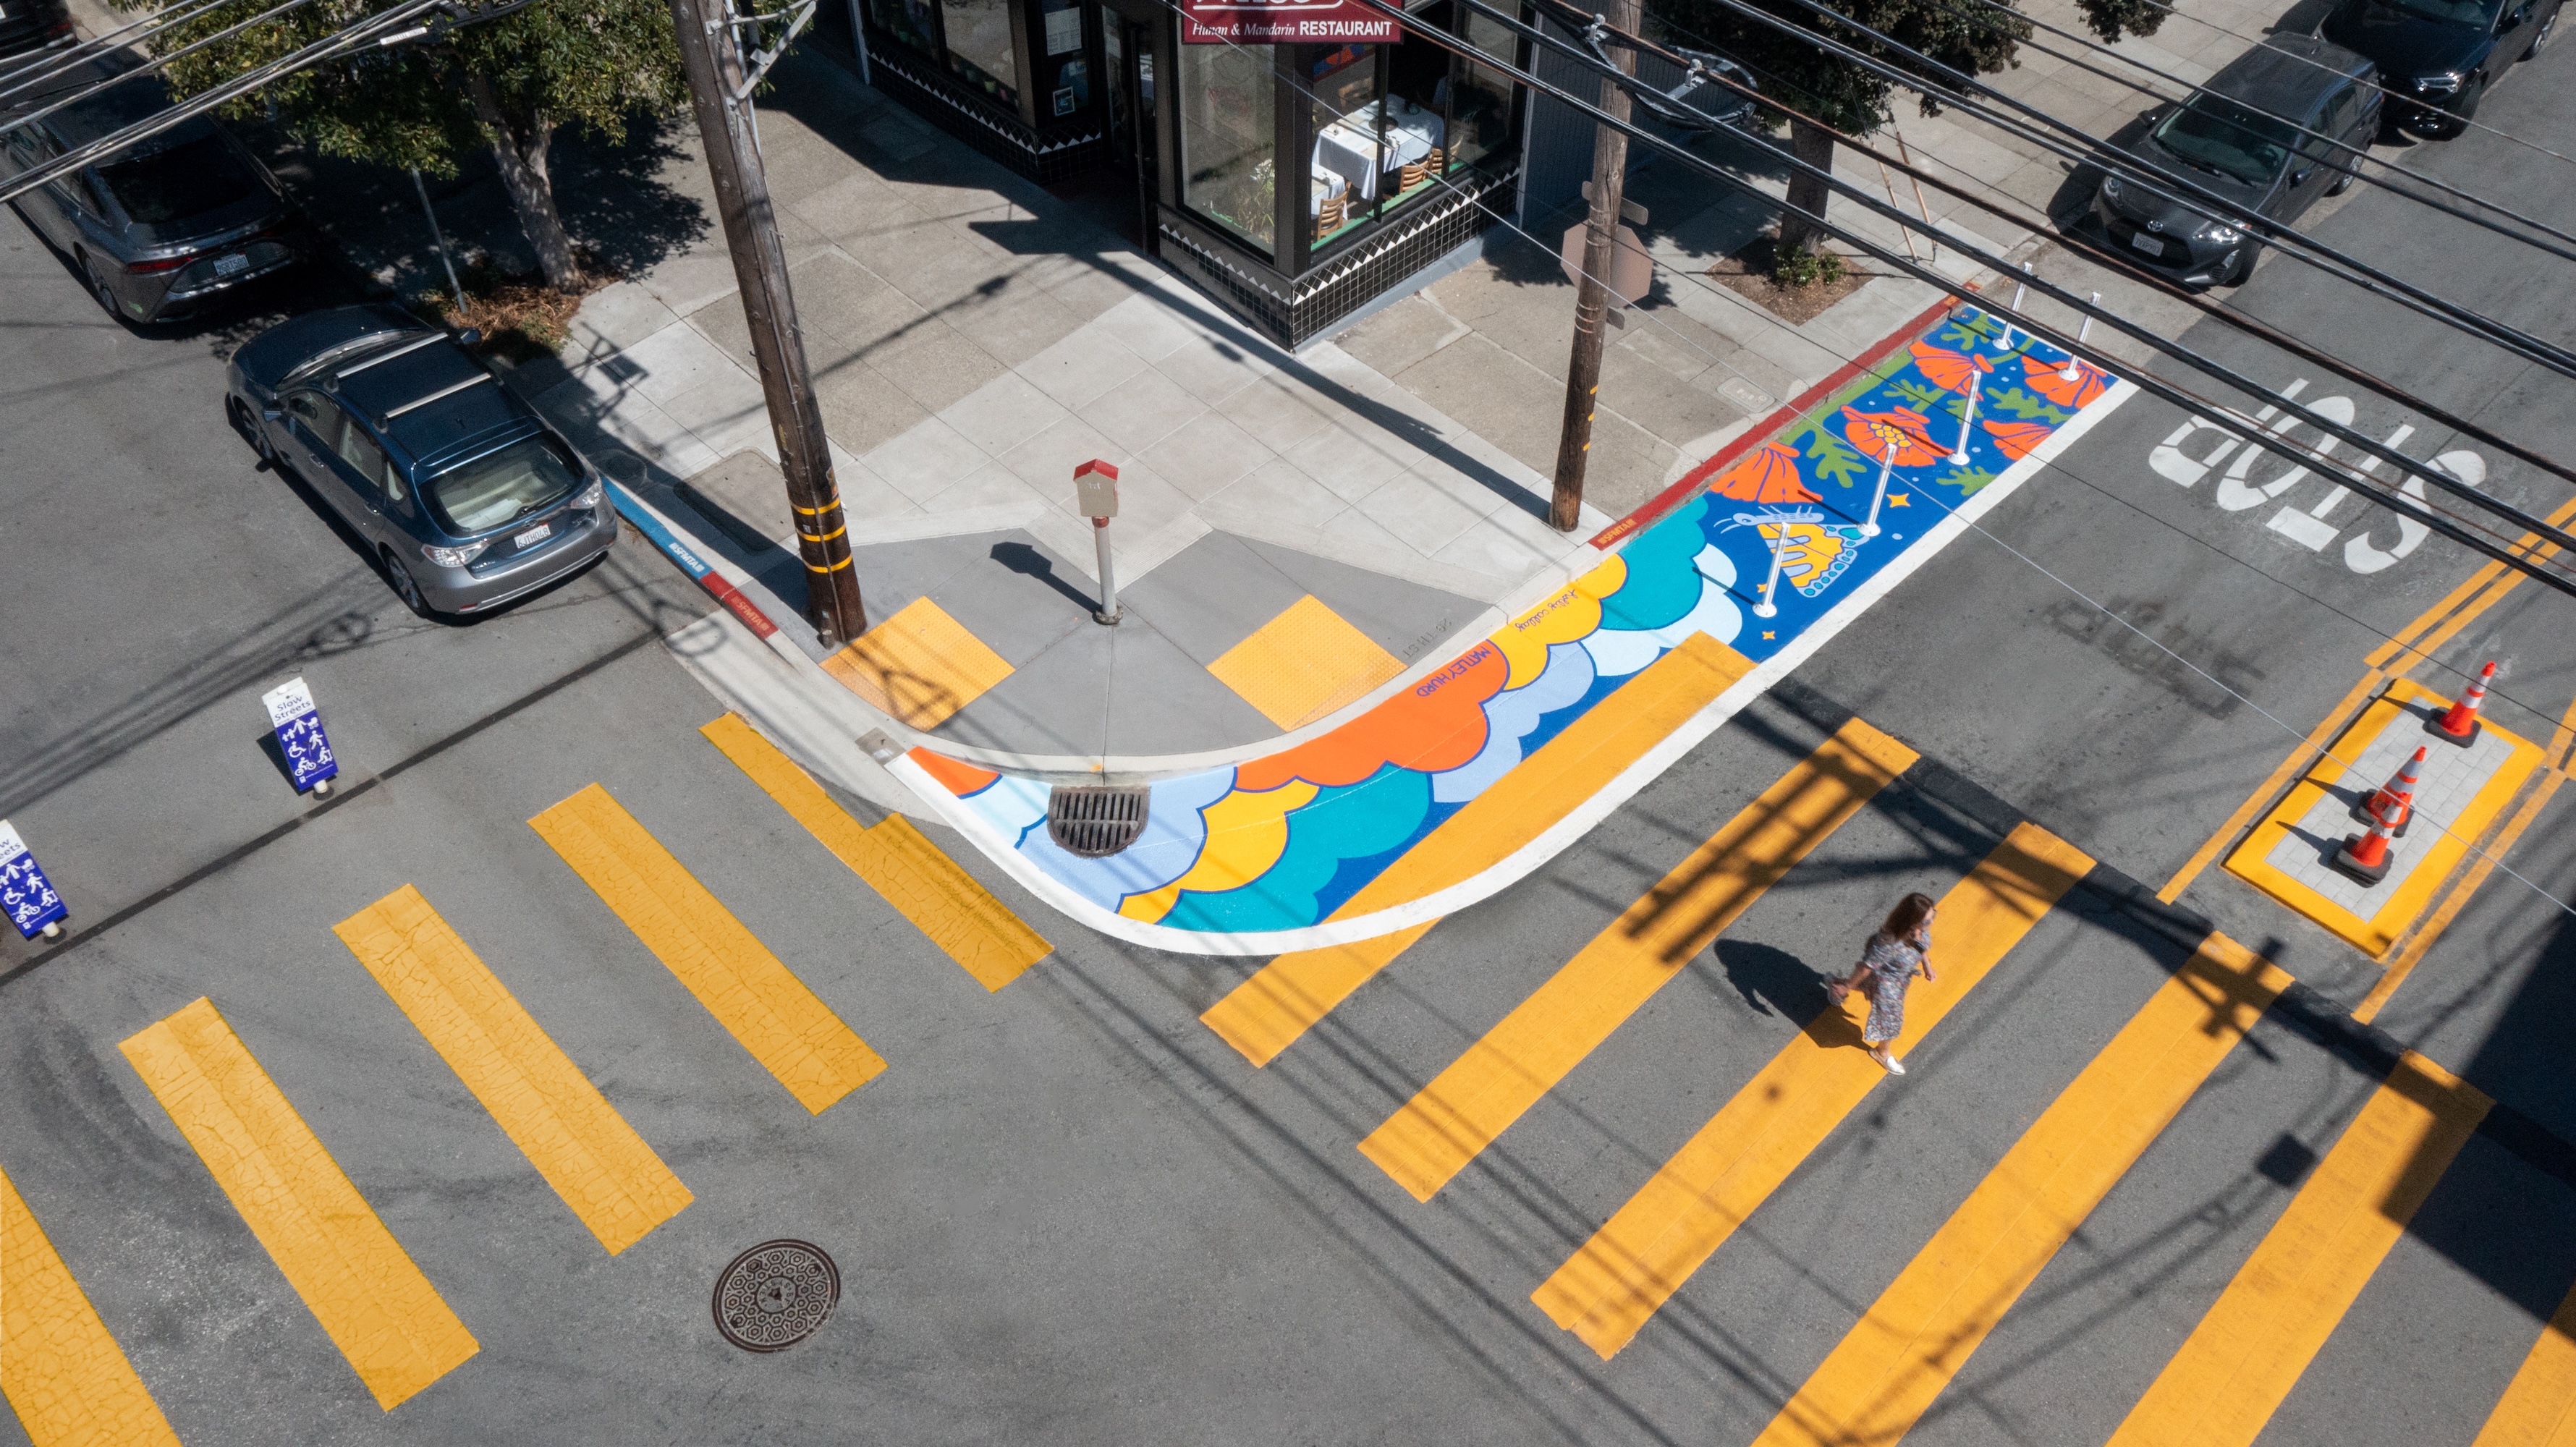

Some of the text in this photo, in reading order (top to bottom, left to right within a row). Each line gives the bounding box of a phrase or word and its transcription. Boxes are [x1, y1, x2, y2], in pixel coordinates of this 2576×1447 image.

[1192, 21, 1393, 35] Hunan & Mandarin RESTAURANT
[2148, 378, 2486, 574] STOP
[518, 527, 549, 548] 6JTH048
[674, 546, 698, 569] SFMTA
[737, 601, 763, 627] SFMTA
[1416, 646, 1492, 697] MATLEY HURD
[274, 701, 310, 721] Streets
[277, 695, 302, 711] Slow
[0, 843, 21, 859] eets
